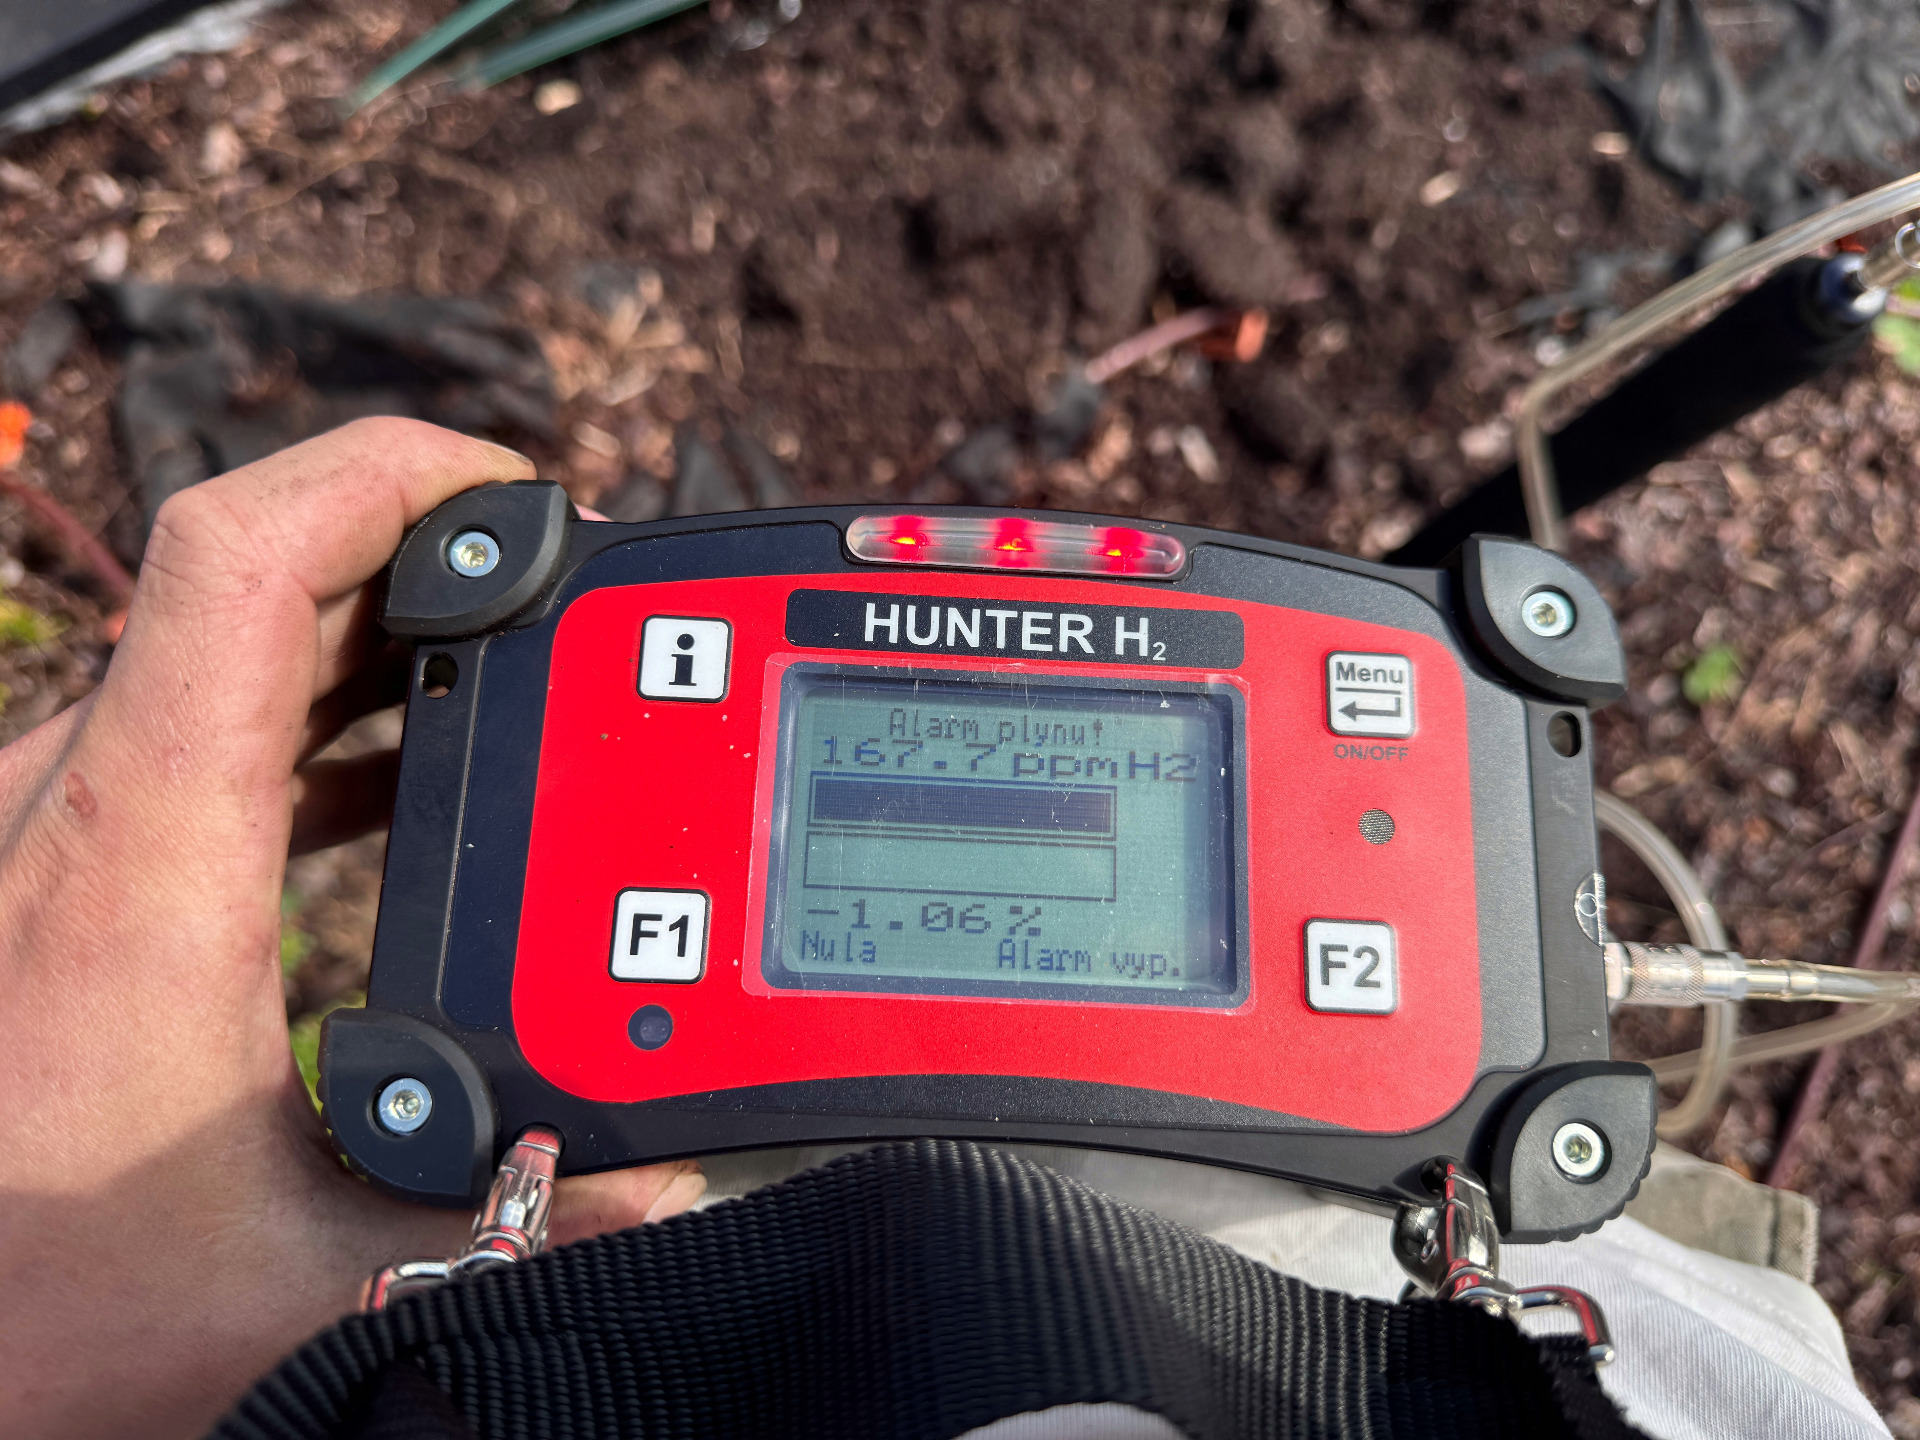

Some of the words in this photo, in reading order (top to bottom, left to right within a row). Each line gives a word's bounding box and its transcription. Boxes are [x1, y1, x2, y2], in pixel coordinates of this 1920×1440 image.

[864, 602, 1095, 654] HUNTER
[1335, 661, 1403, 684] Menu
[889, 707, 979, 740] Alarm
[999, 714, 1103, 747] plynu!
[823, 735, 997, 772] 167.7
[1333, 743, 1409, 761] ON/OFF
[629, 913, 690, 958] F1
[801, 930, 877, 963] Nula
[999, 938, 1092, 973] Alarm
[1112, 952, 1180, 980] vyp.
[1319, 943, 1381, 989] F2
